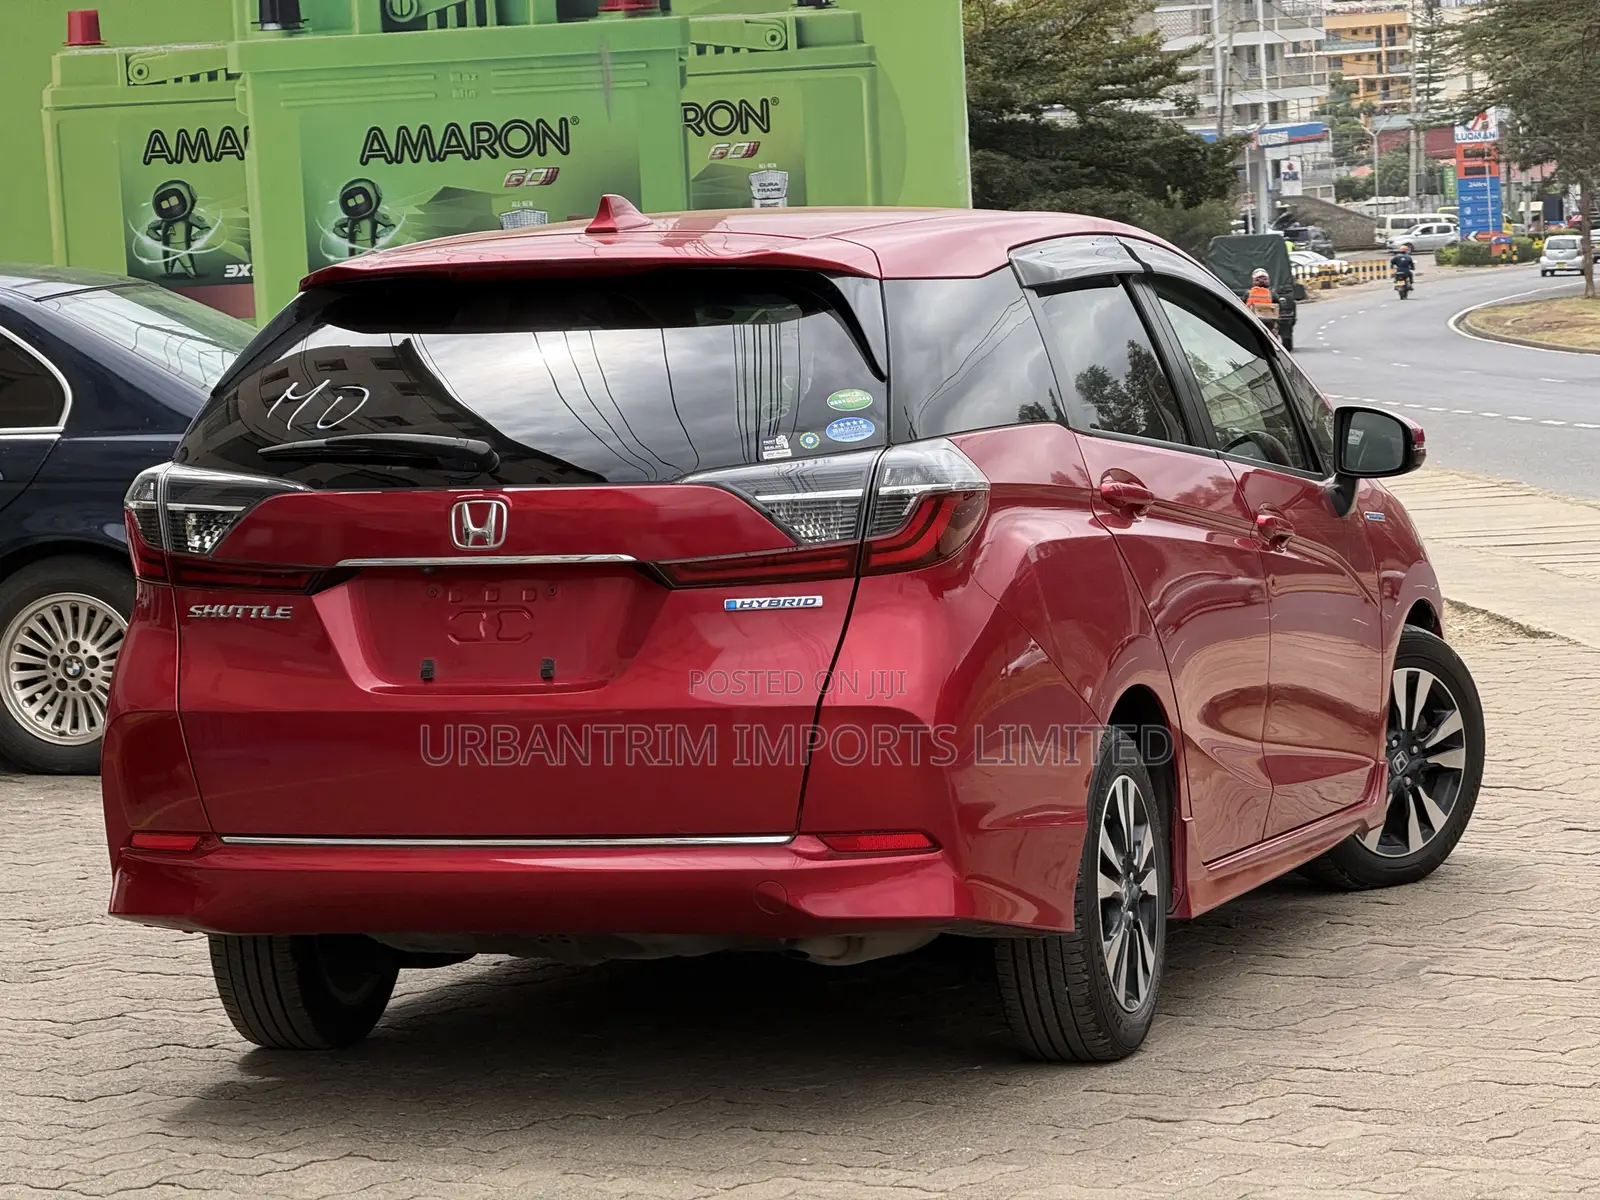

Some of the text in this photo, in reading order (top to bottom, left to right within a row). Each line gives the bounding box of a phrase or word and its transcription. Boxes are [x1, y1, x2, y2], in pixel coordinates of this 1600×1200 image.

[143, 125, 249, 165] AMA
[739, 597, 817, 609] HYBRID
[187, 604, 294, 619] SHUTTLE
